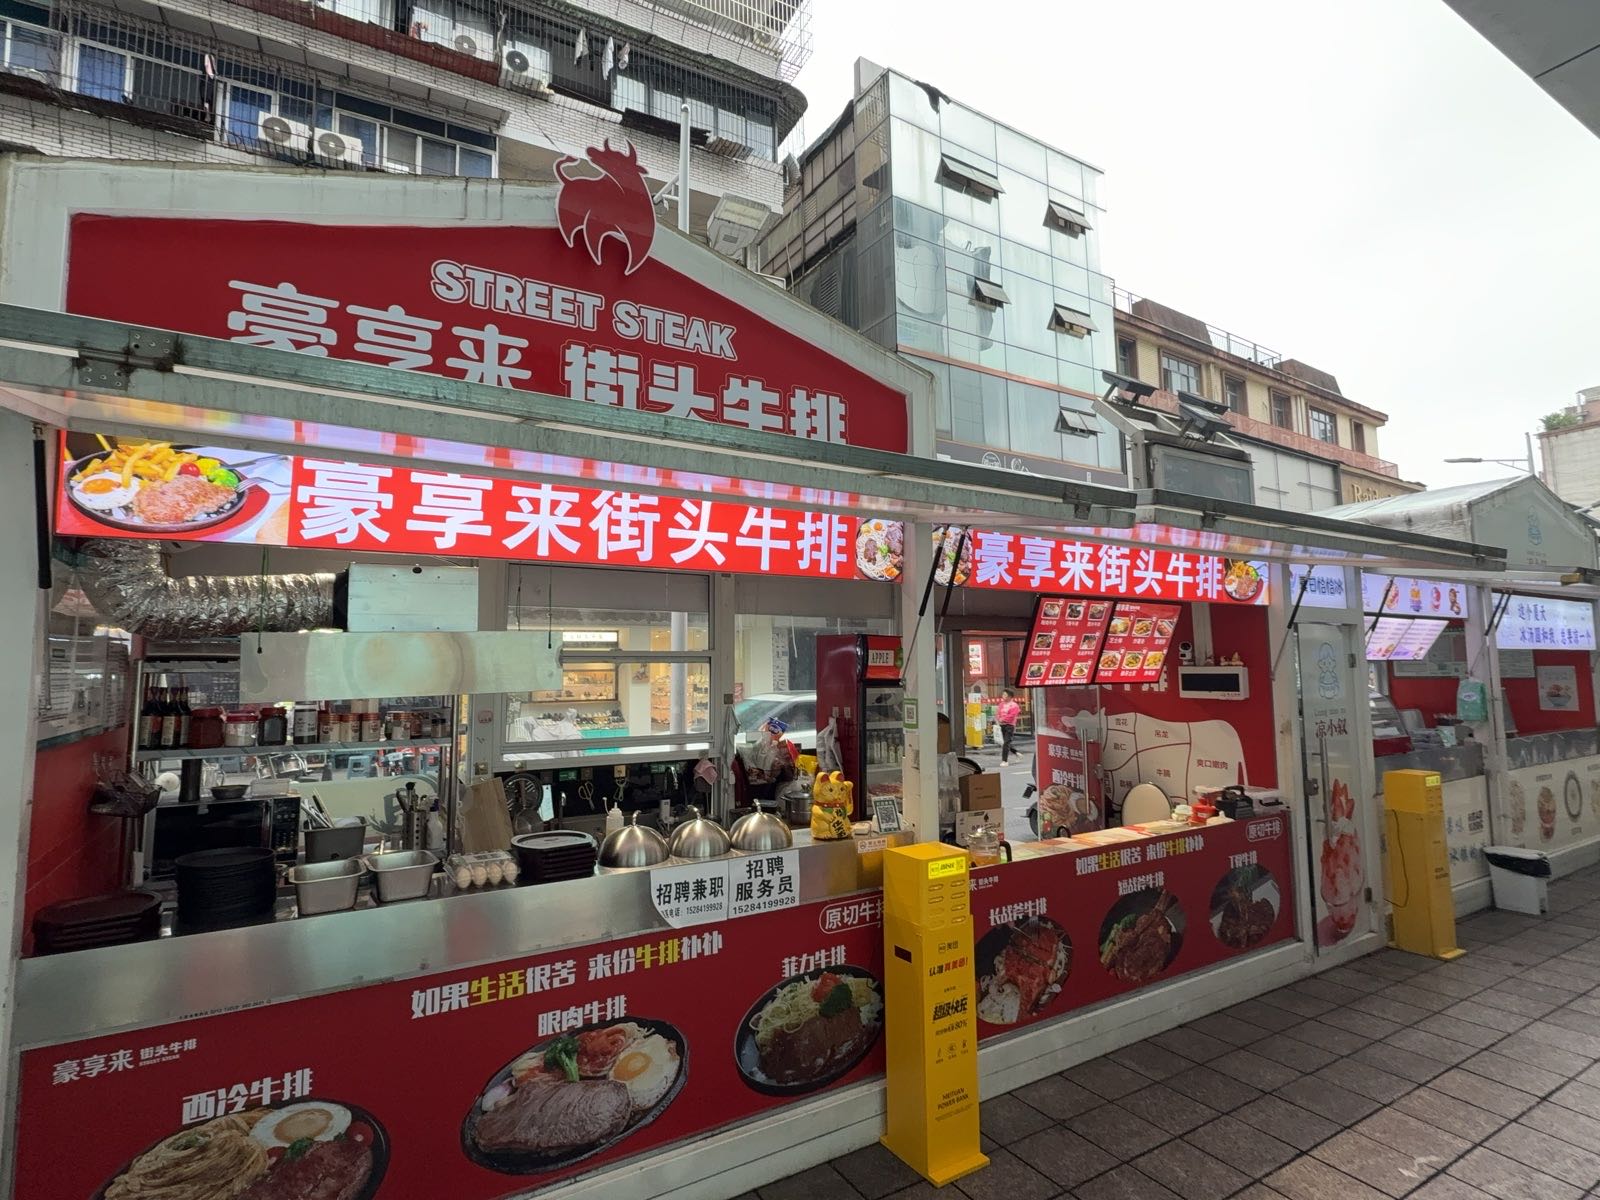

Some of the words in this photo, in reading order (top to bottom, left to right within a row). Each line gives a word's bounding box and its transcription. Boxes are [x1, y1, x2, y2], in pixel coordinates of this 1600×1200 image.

[431, 259, 604, 332] STREET
[612, 300, 737, 361] STEAK
[297, 457, 849, 575] 豪享来街头牛排
[975, 531, 1223, 599] 豪享来街头牛排
[871, 652, 889, 664] APPLE
[745, 855, 785, 880] 招聘
[1076, 846, 1142, 876] 如果生活很苦
[655, 876, 724, 906] 招聘兼职
[735, 875, 794, 903] 服务员
[686, 902, 724, 915] 15284199928
[732, 896, 796, 915] 15284199928
[989, 897, 1048, 927] 长战斧牛排
[410, 958, 577, 1020] 如果生活很苦
[588, 930, 723, 982] 来份牛排补补
[781, 944, 847, 978] 菲力牛排
[537, 994, 628, 1037] 眼肉牛排
[52, 1048, 134, 1086] 豪享来
[139, 1037, 198, 1061] 街头牛排
[181, 1067, 314, 1126] 西冷牛排
